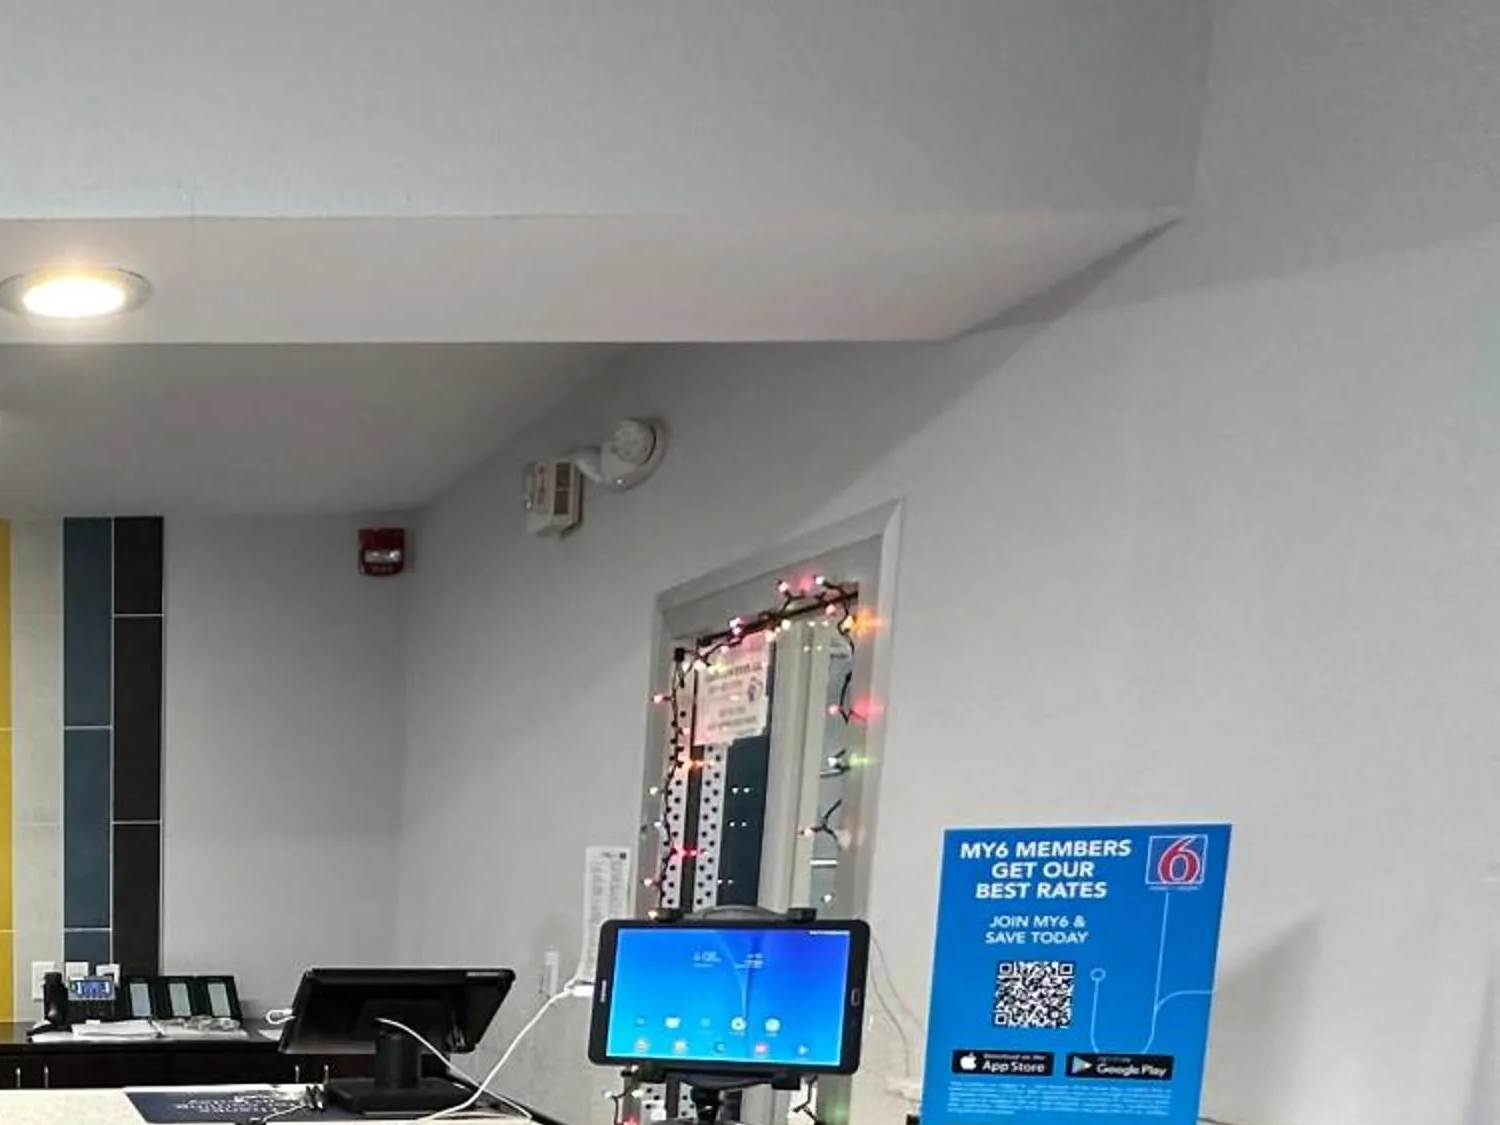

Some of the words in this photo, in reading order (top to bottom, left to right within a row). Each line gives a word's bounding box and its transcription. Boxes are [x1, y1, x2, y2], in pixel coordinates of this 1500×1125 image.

[960, 842, 1009, 859] MY6
[1015, 839, 1133, 858] MEMBERS
[1157, 835, 1201, 885] 6
[991, 862, 1037, 879] GET
[1043, 862, 1095, 879] OUR
[975, 882, 1030, 899] BEST
[1036, 881, 1108, 899] RATES
[989, 915, 1029, 928] JOIN
[1033, 915, 1069, 928] MY6
[1073, 915, 1086, 928] &
[985, 931, 1025, 944] SAVE
[1031, 931, 1089, 944] TODAY
[981, 1060, 1009, 1073] App
[1011, 1061, 1046, 1073] Store
[1096, 1063, 1140, 1077] Google
[1141, 1064, 1168, 1078] Play
